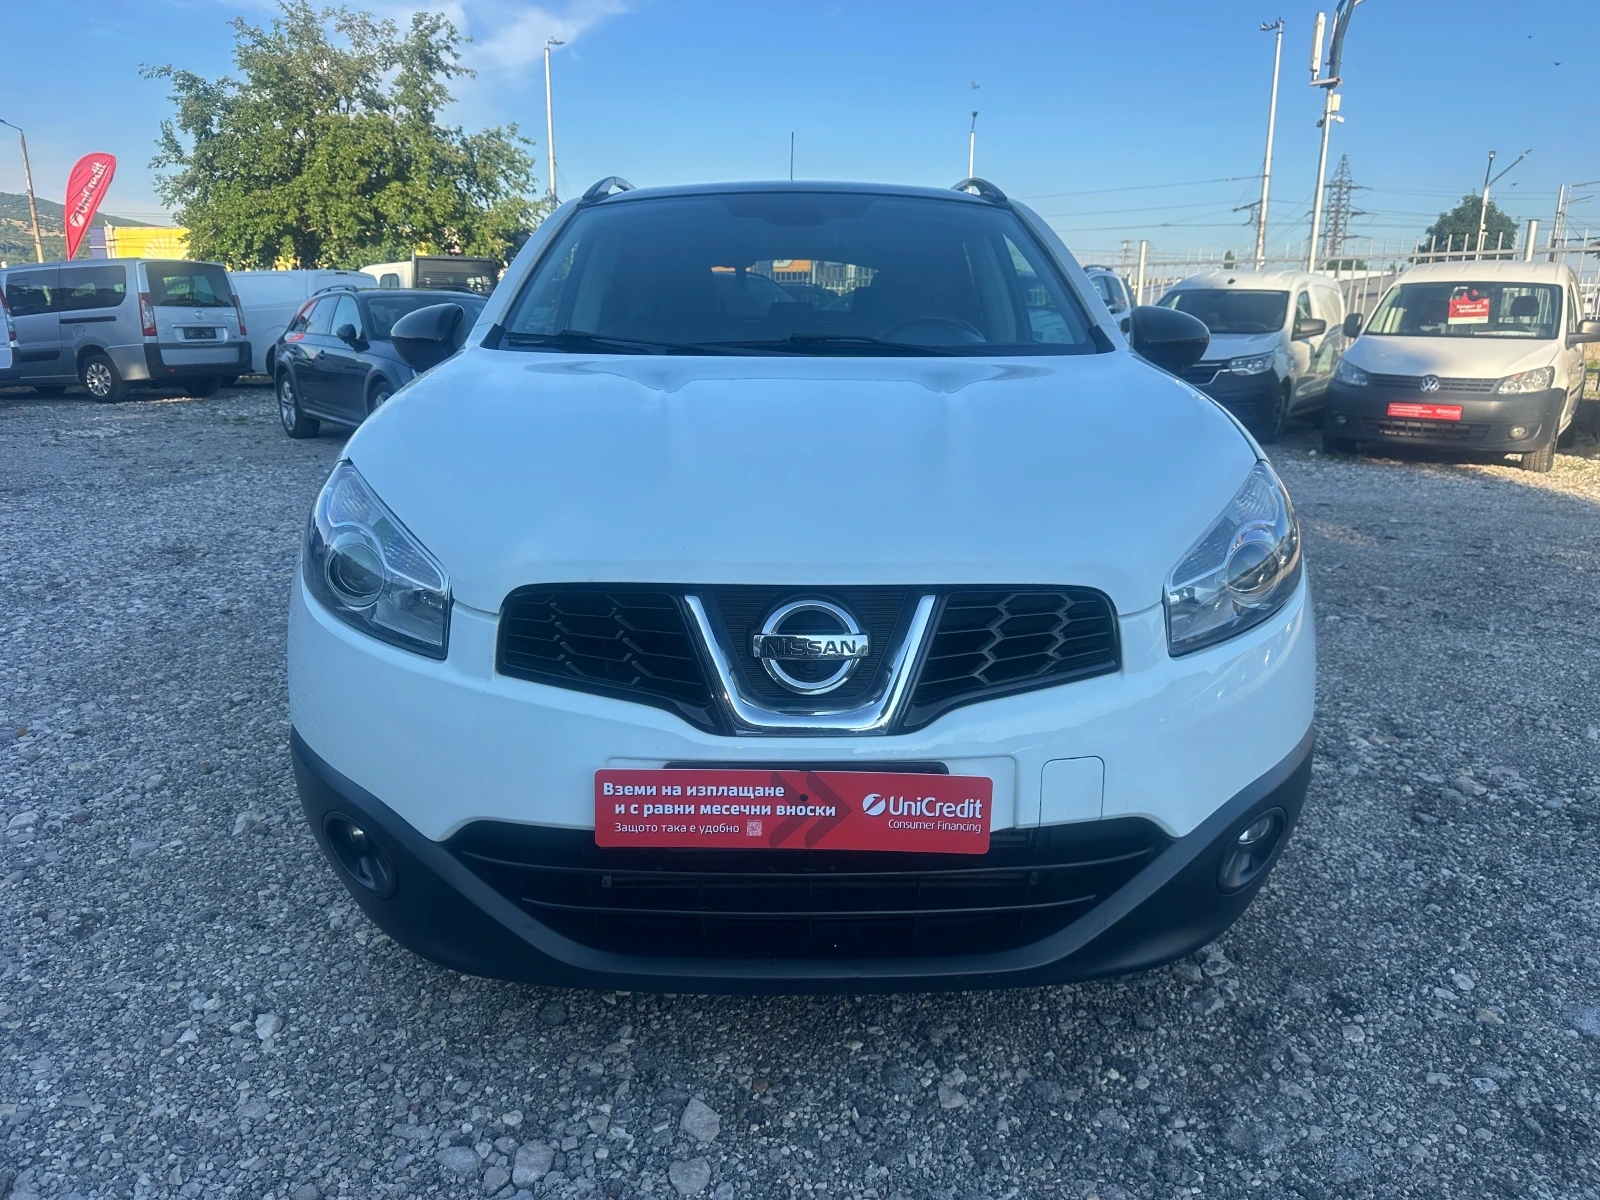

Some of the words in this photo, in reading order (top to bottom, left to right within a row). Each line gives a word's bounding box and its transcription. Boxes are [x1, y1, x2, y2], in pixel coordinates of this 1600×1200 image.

[76, 161, 106, 214] UniCredit
[764, 640, 857, 656] NISSAN
[603, 782, 657, 796] Вземи
[661, 785, 682, 796] на
[686, 785, 785, 799] изплащане
[615, 803, 626, 815] и
[630, 803, 639, 815] с
[643, 803, 695, 818] равни
[699, 803, 772, 816] месечни
[776, 804, 837, 817] вноски
[888, 795, 983, 819] UniCredit
[614, 822, 658, 834] Защото
[660, 824, 687, 833] така
[689, 824, 697, 833] е
[699, 822, 740, 835] удобно
[888, 818, 936, 830] Consumer
[937, 820, 982, 835] Financing
